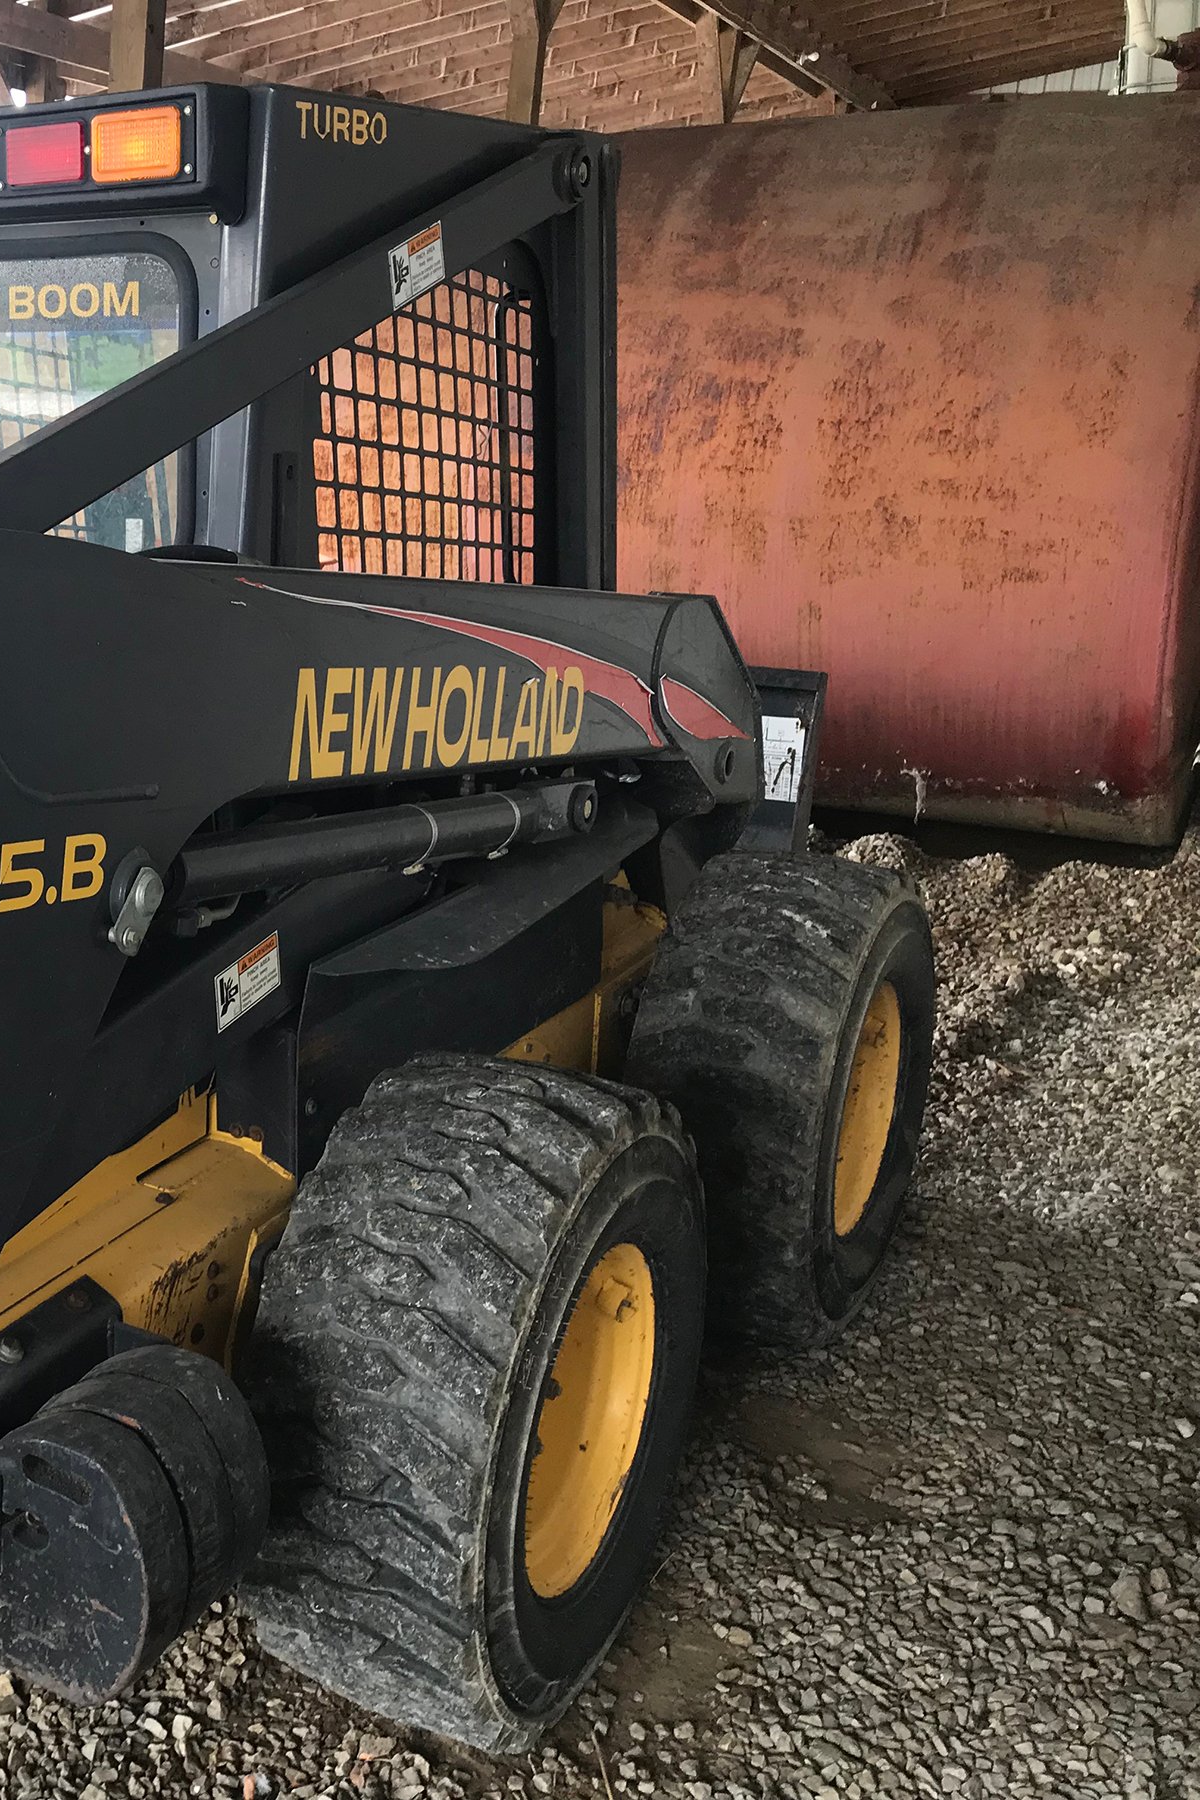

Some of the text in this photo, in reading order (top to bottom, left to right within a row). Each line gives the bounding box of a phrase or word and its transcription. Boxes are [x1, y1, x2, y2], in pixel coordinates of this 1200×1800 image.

[296, 101, 388, 145] TURBO
[8, 281, 140, 320] BOOM
[288, 664, 585, 782] NEW HOLLAND
